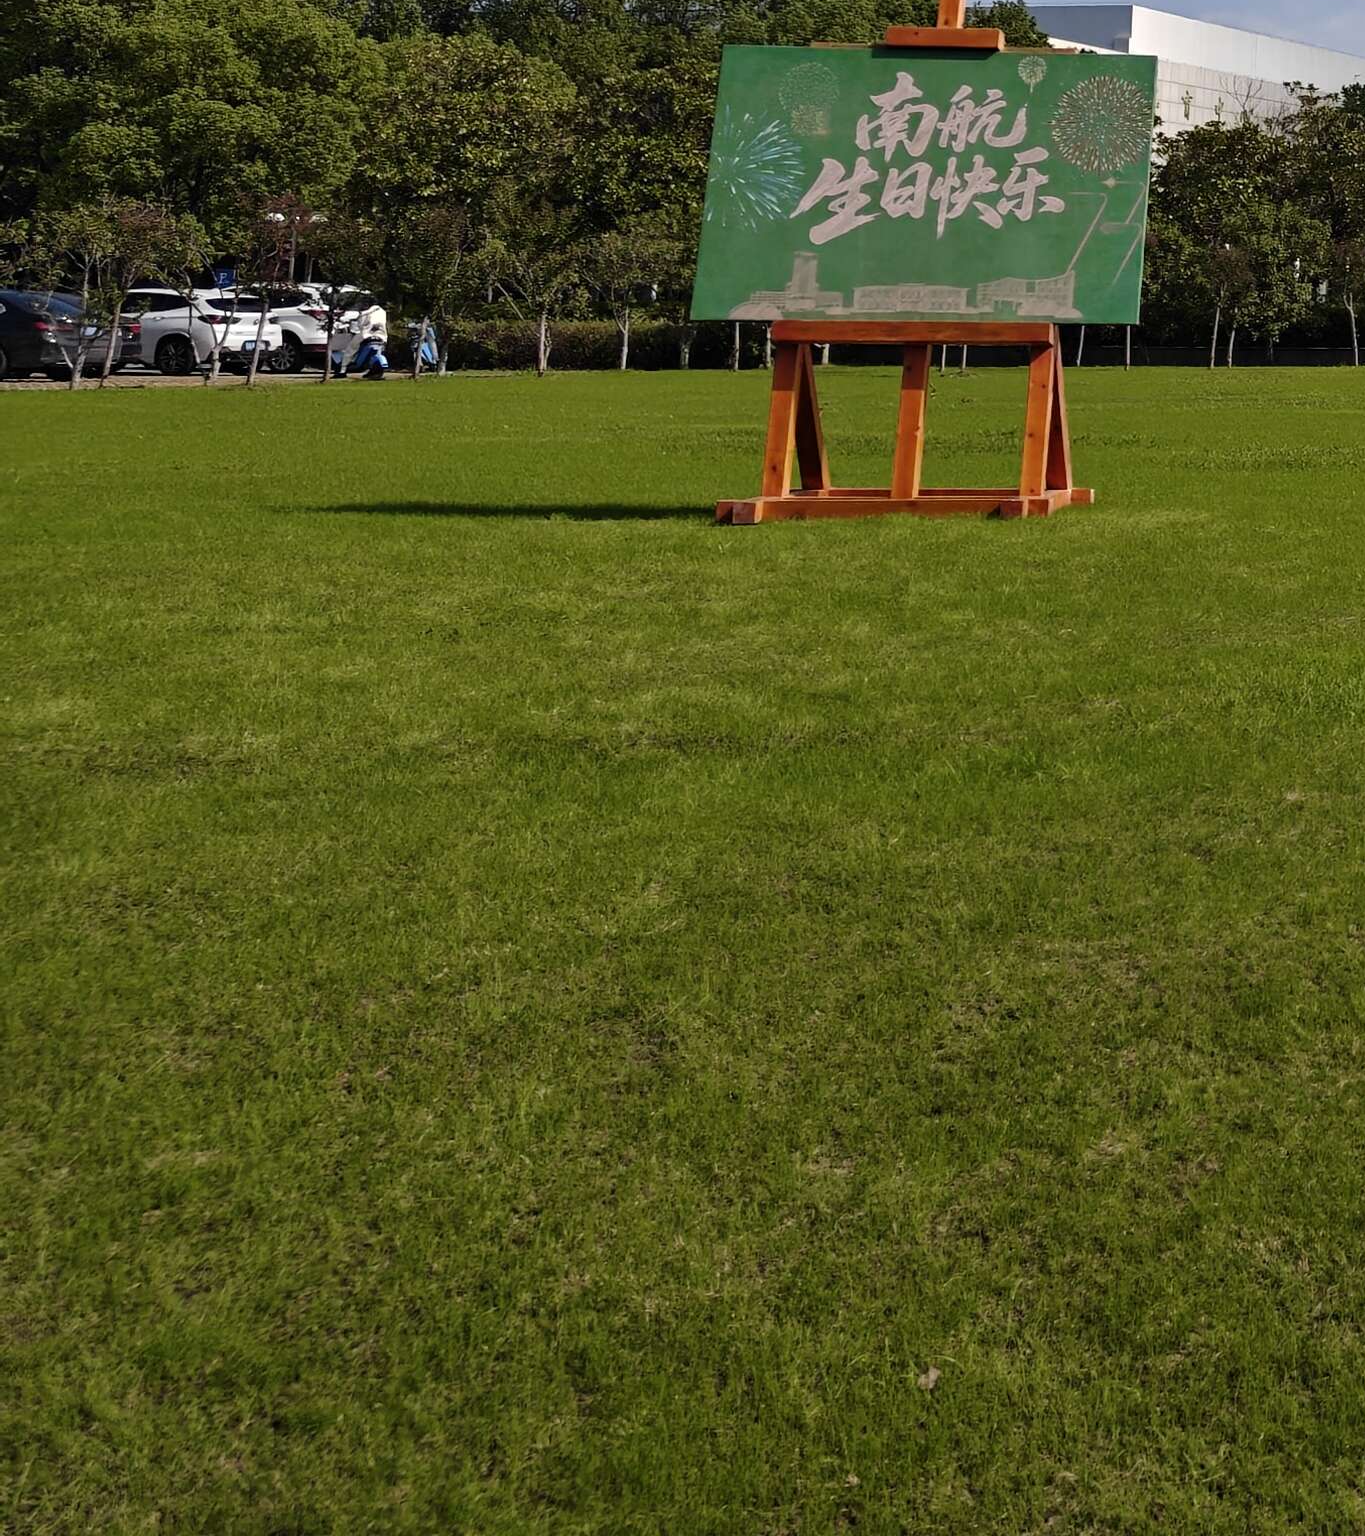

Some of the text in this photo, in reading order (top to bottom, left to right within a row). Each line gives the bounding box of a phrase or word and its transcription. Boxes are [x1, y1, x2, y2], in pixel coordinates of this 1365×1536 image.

[855, 72, 1027, 161] 南航
[790, 148, 1065, 245] 生日快乐
